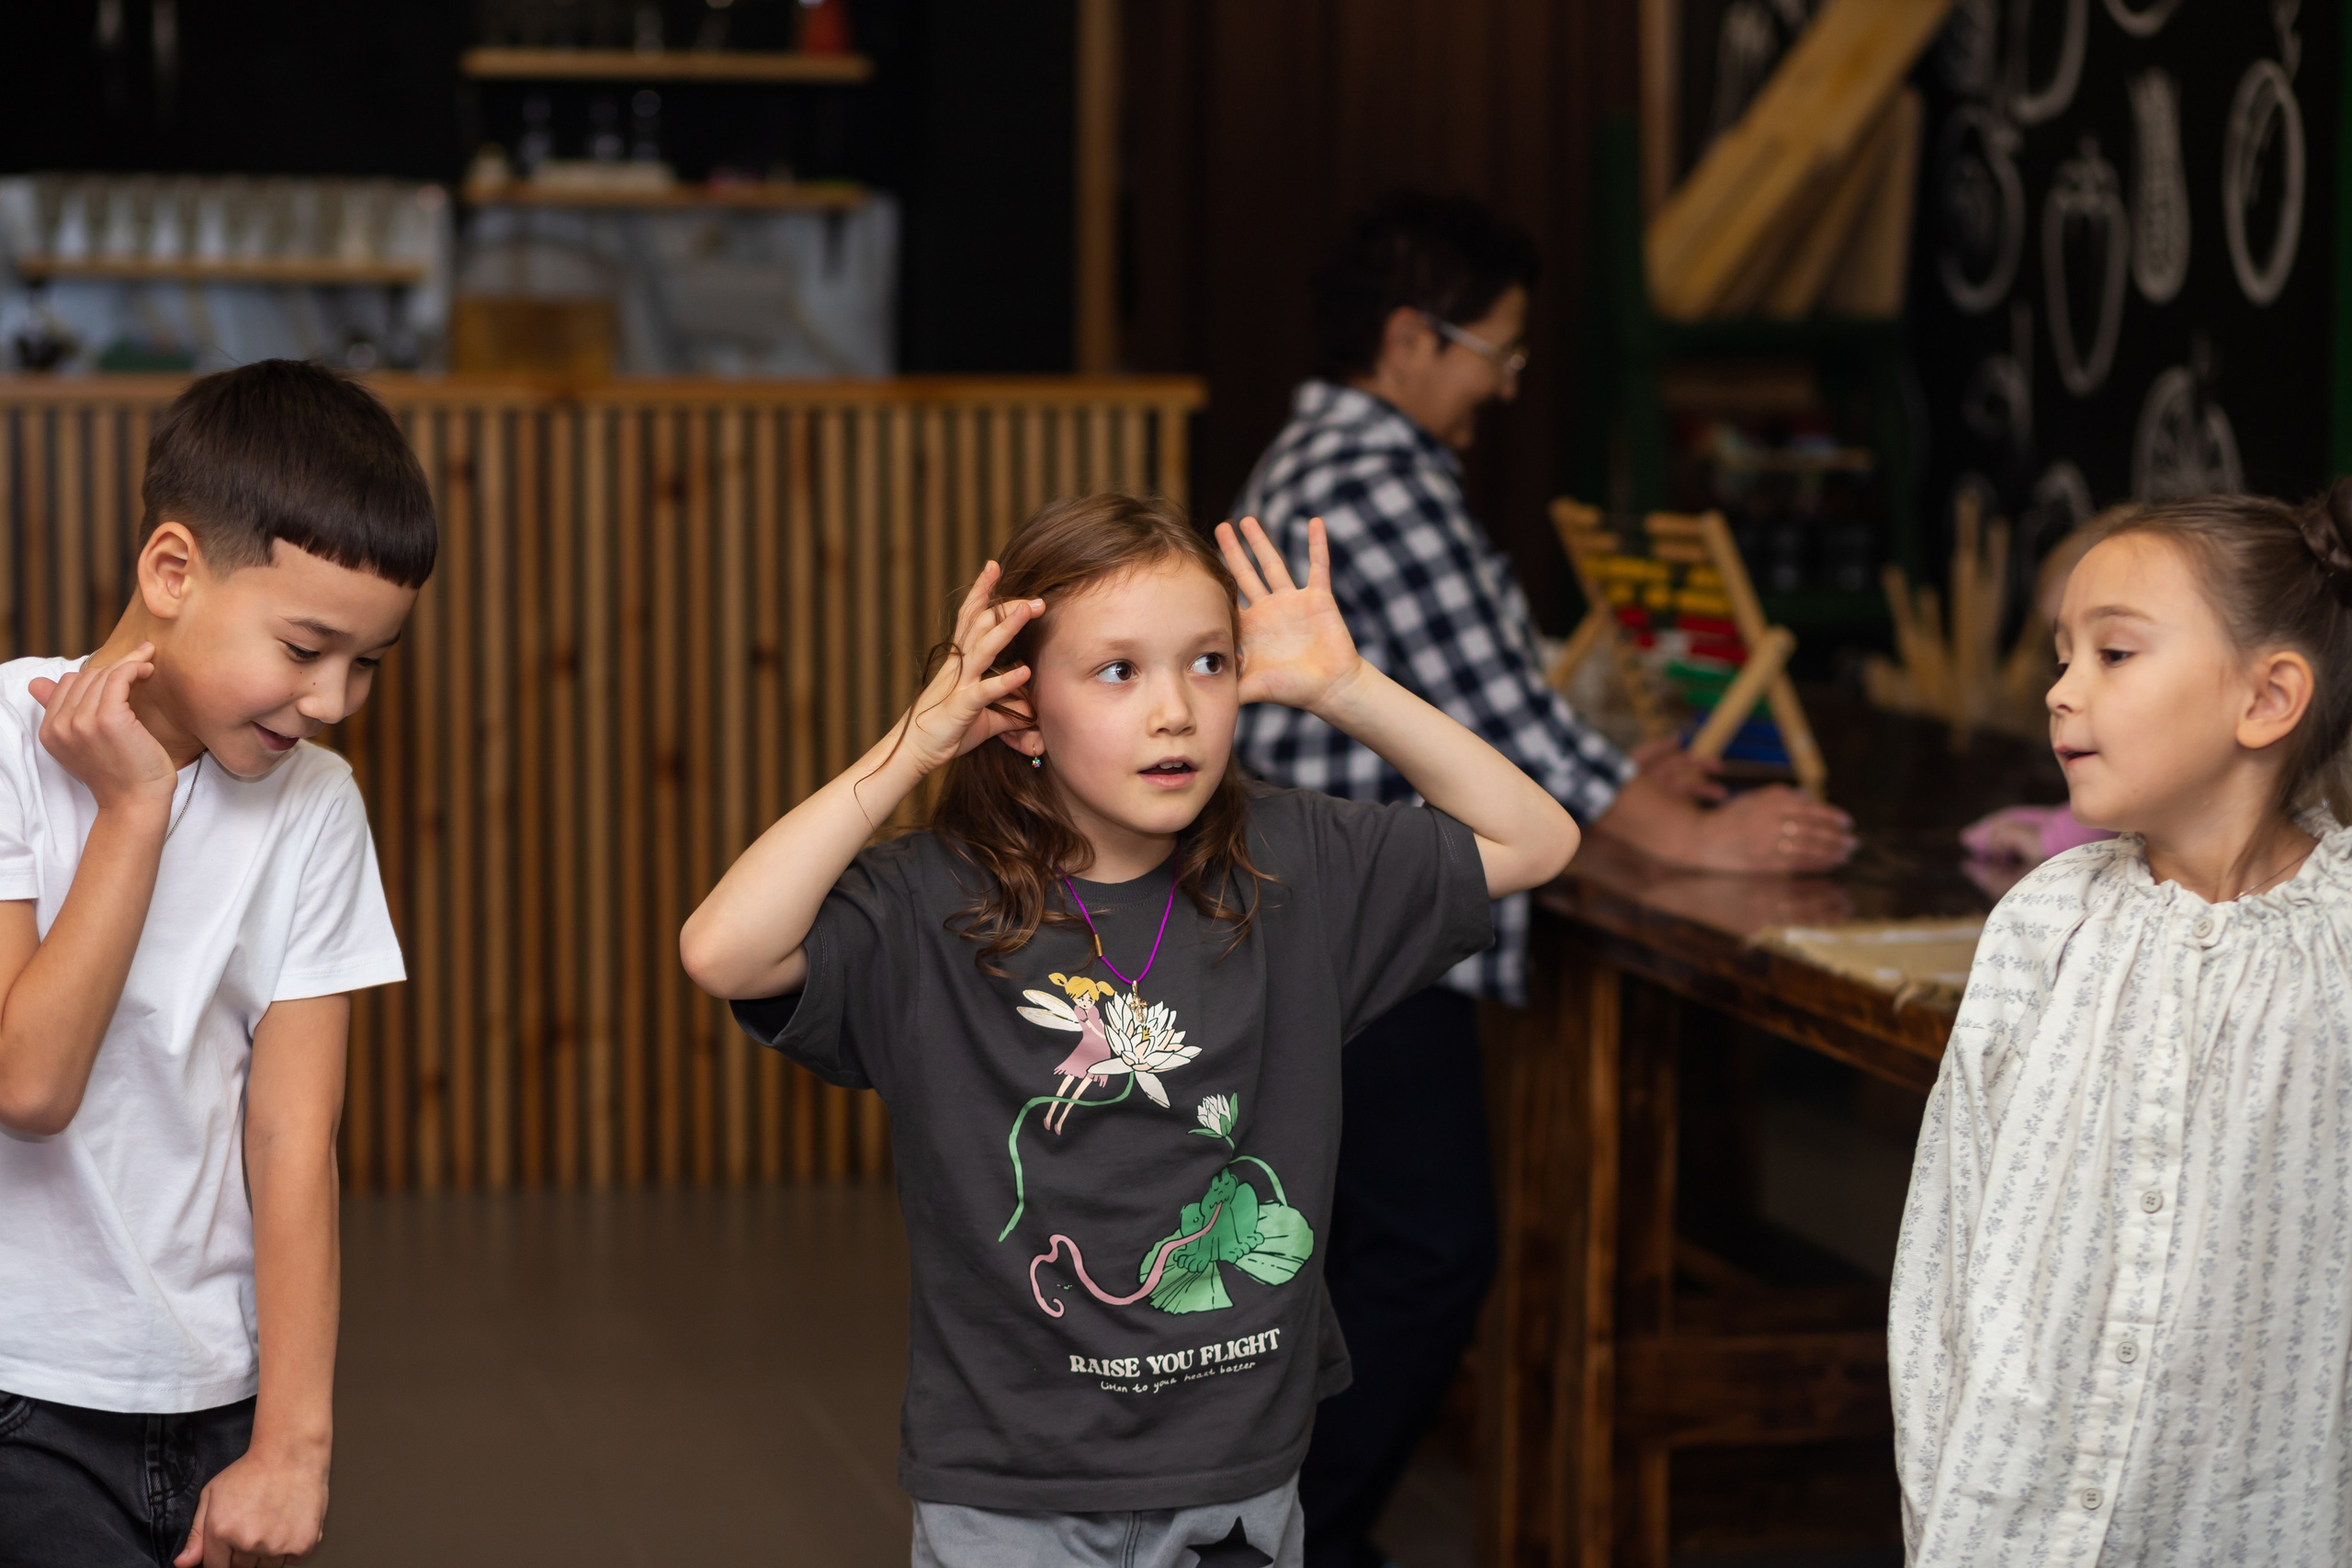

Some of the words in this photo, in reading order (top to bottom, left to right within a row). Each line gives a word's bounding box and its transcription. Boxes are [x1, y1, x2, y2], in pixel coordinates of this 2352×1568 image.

[1069, 1355, 1141, 1378] RAISE
[1146, 1349, 1194, 1375] YOU
[1199, 1328, 1281, 1366] FLIGHT
[1132, 1383, 1148, 1393] to
